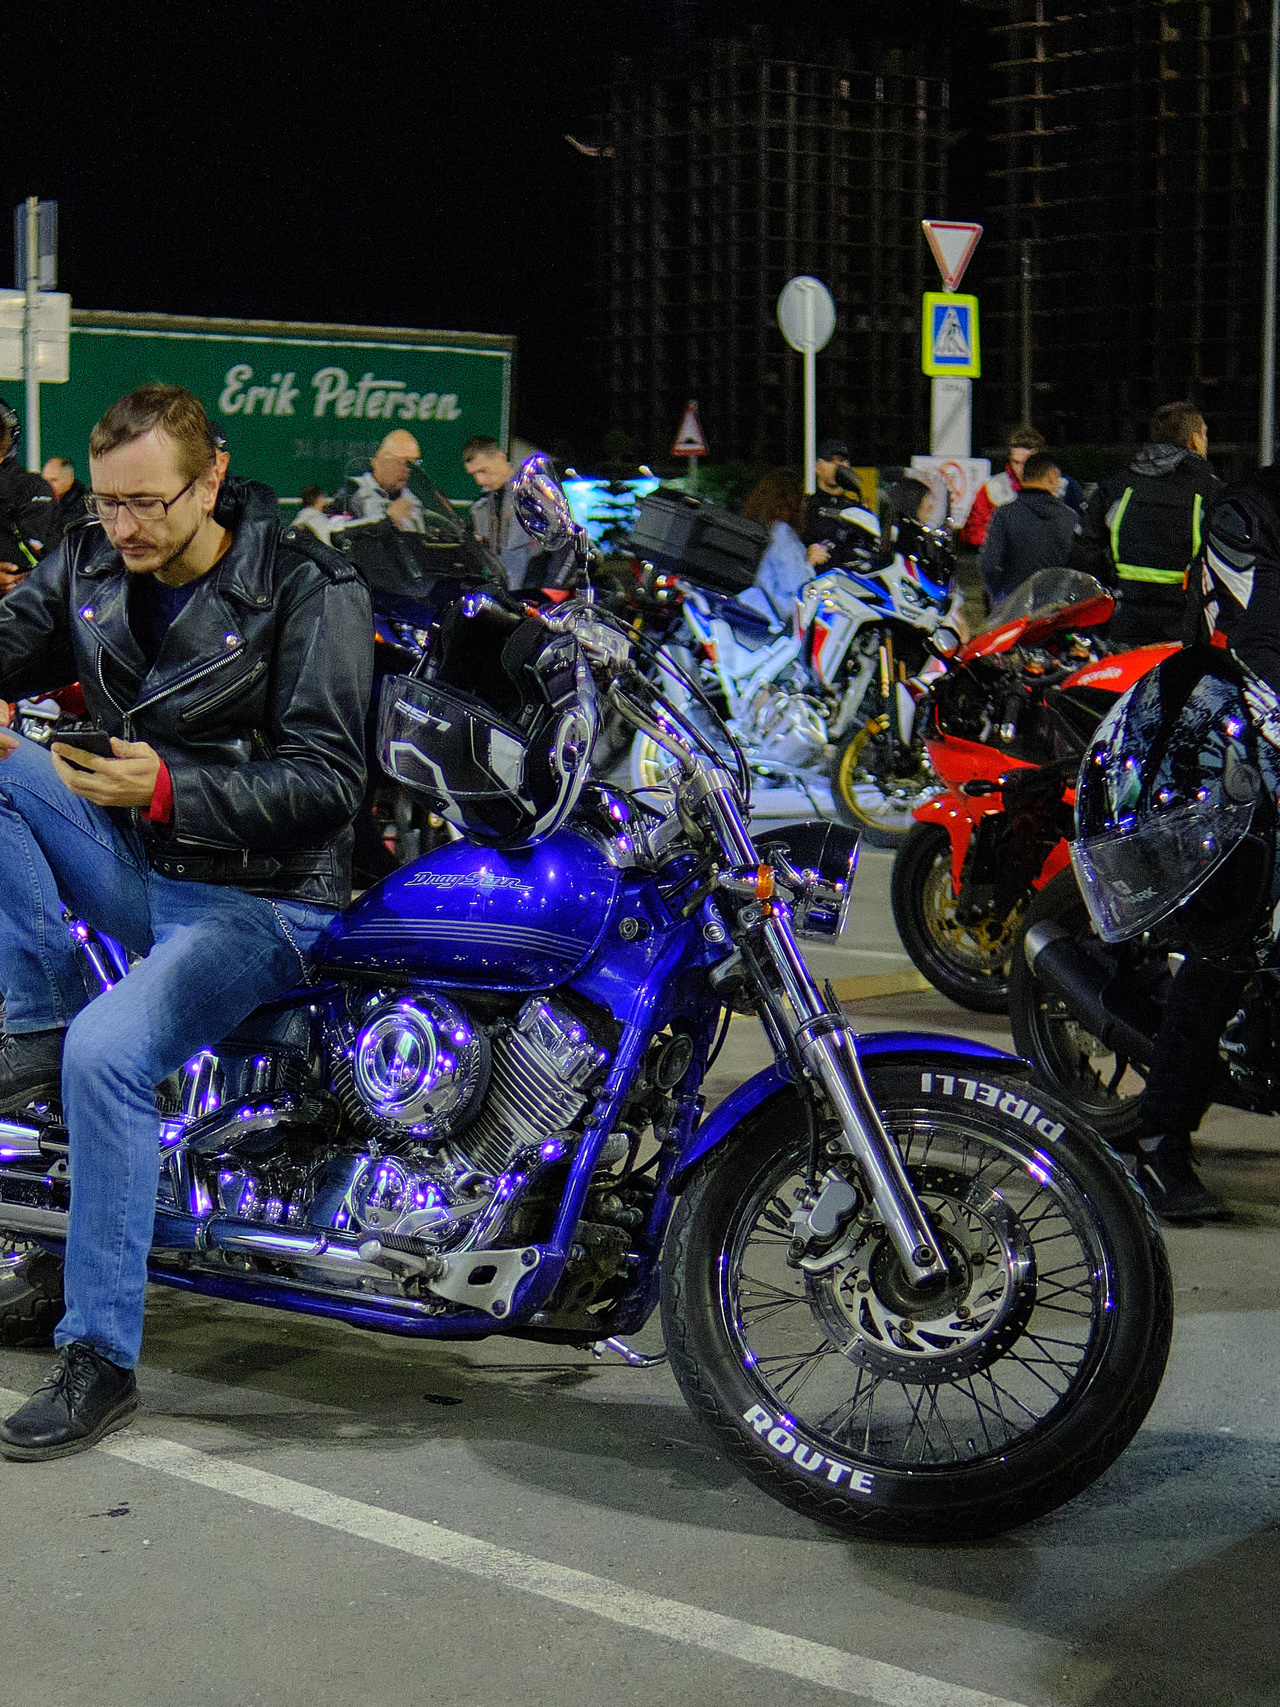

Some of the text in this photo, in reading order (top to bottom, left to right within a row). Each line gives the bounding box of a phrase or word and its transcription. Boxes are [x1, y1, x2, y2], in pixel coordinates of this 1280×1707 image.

[220, 364, 462, 420] Erik Petersen
[921, 1072, 1066, 1143] PIRELLI
[743, 1403, 875, 1494] ROUTE
